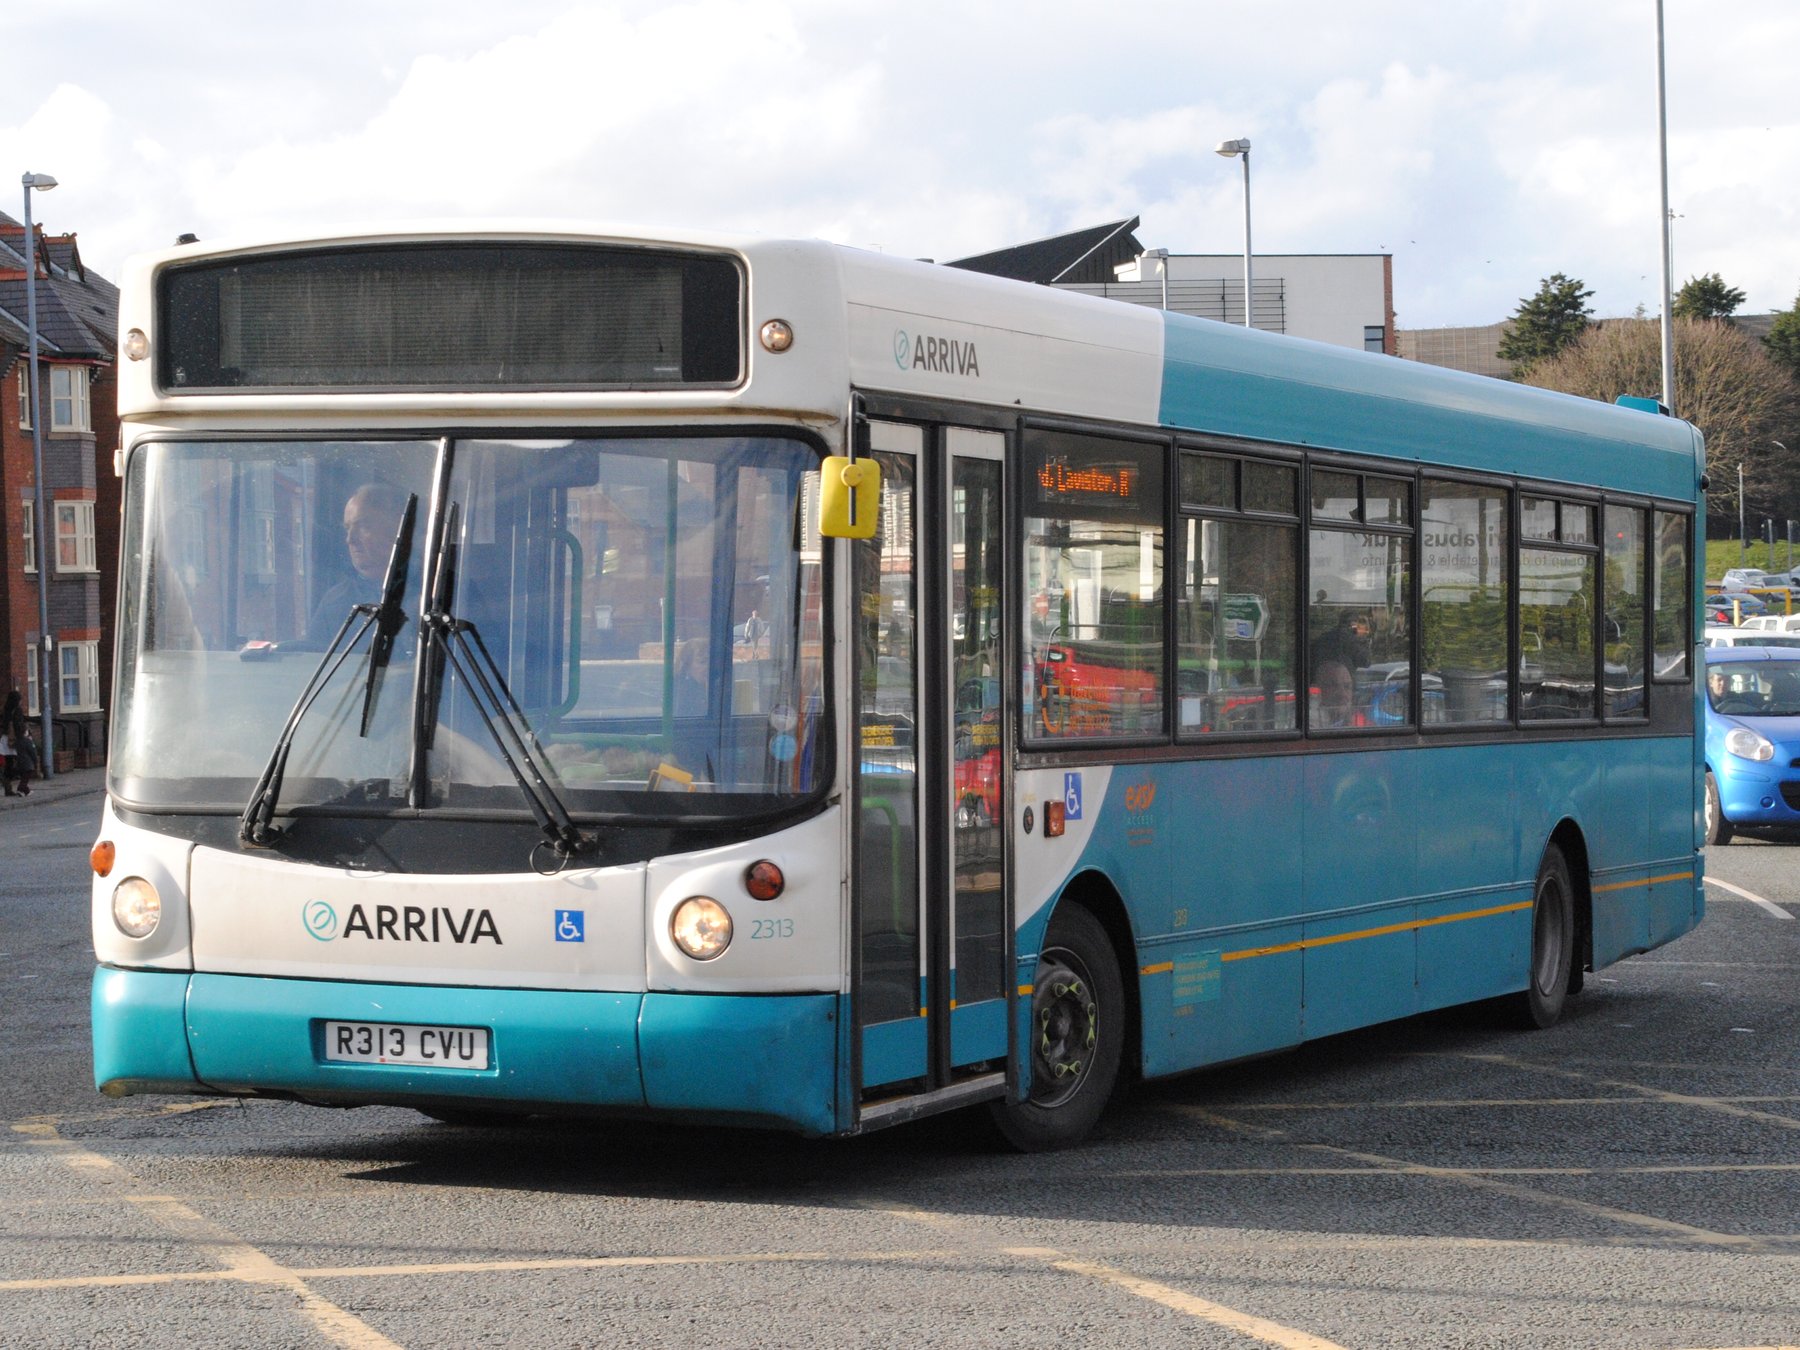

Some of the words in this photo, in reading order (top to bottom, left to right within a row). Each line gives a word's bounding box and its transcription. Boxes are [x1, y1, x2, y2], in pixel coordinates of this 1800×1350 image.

[913, 335, 979, 376] ARRIVA
[343, 904, 503, 945] ARRIVA
[750, 918, 795, 940] 2313
[336, 1026, 405, 1057] R313
[420, 1030, 475, 1061] CVU
